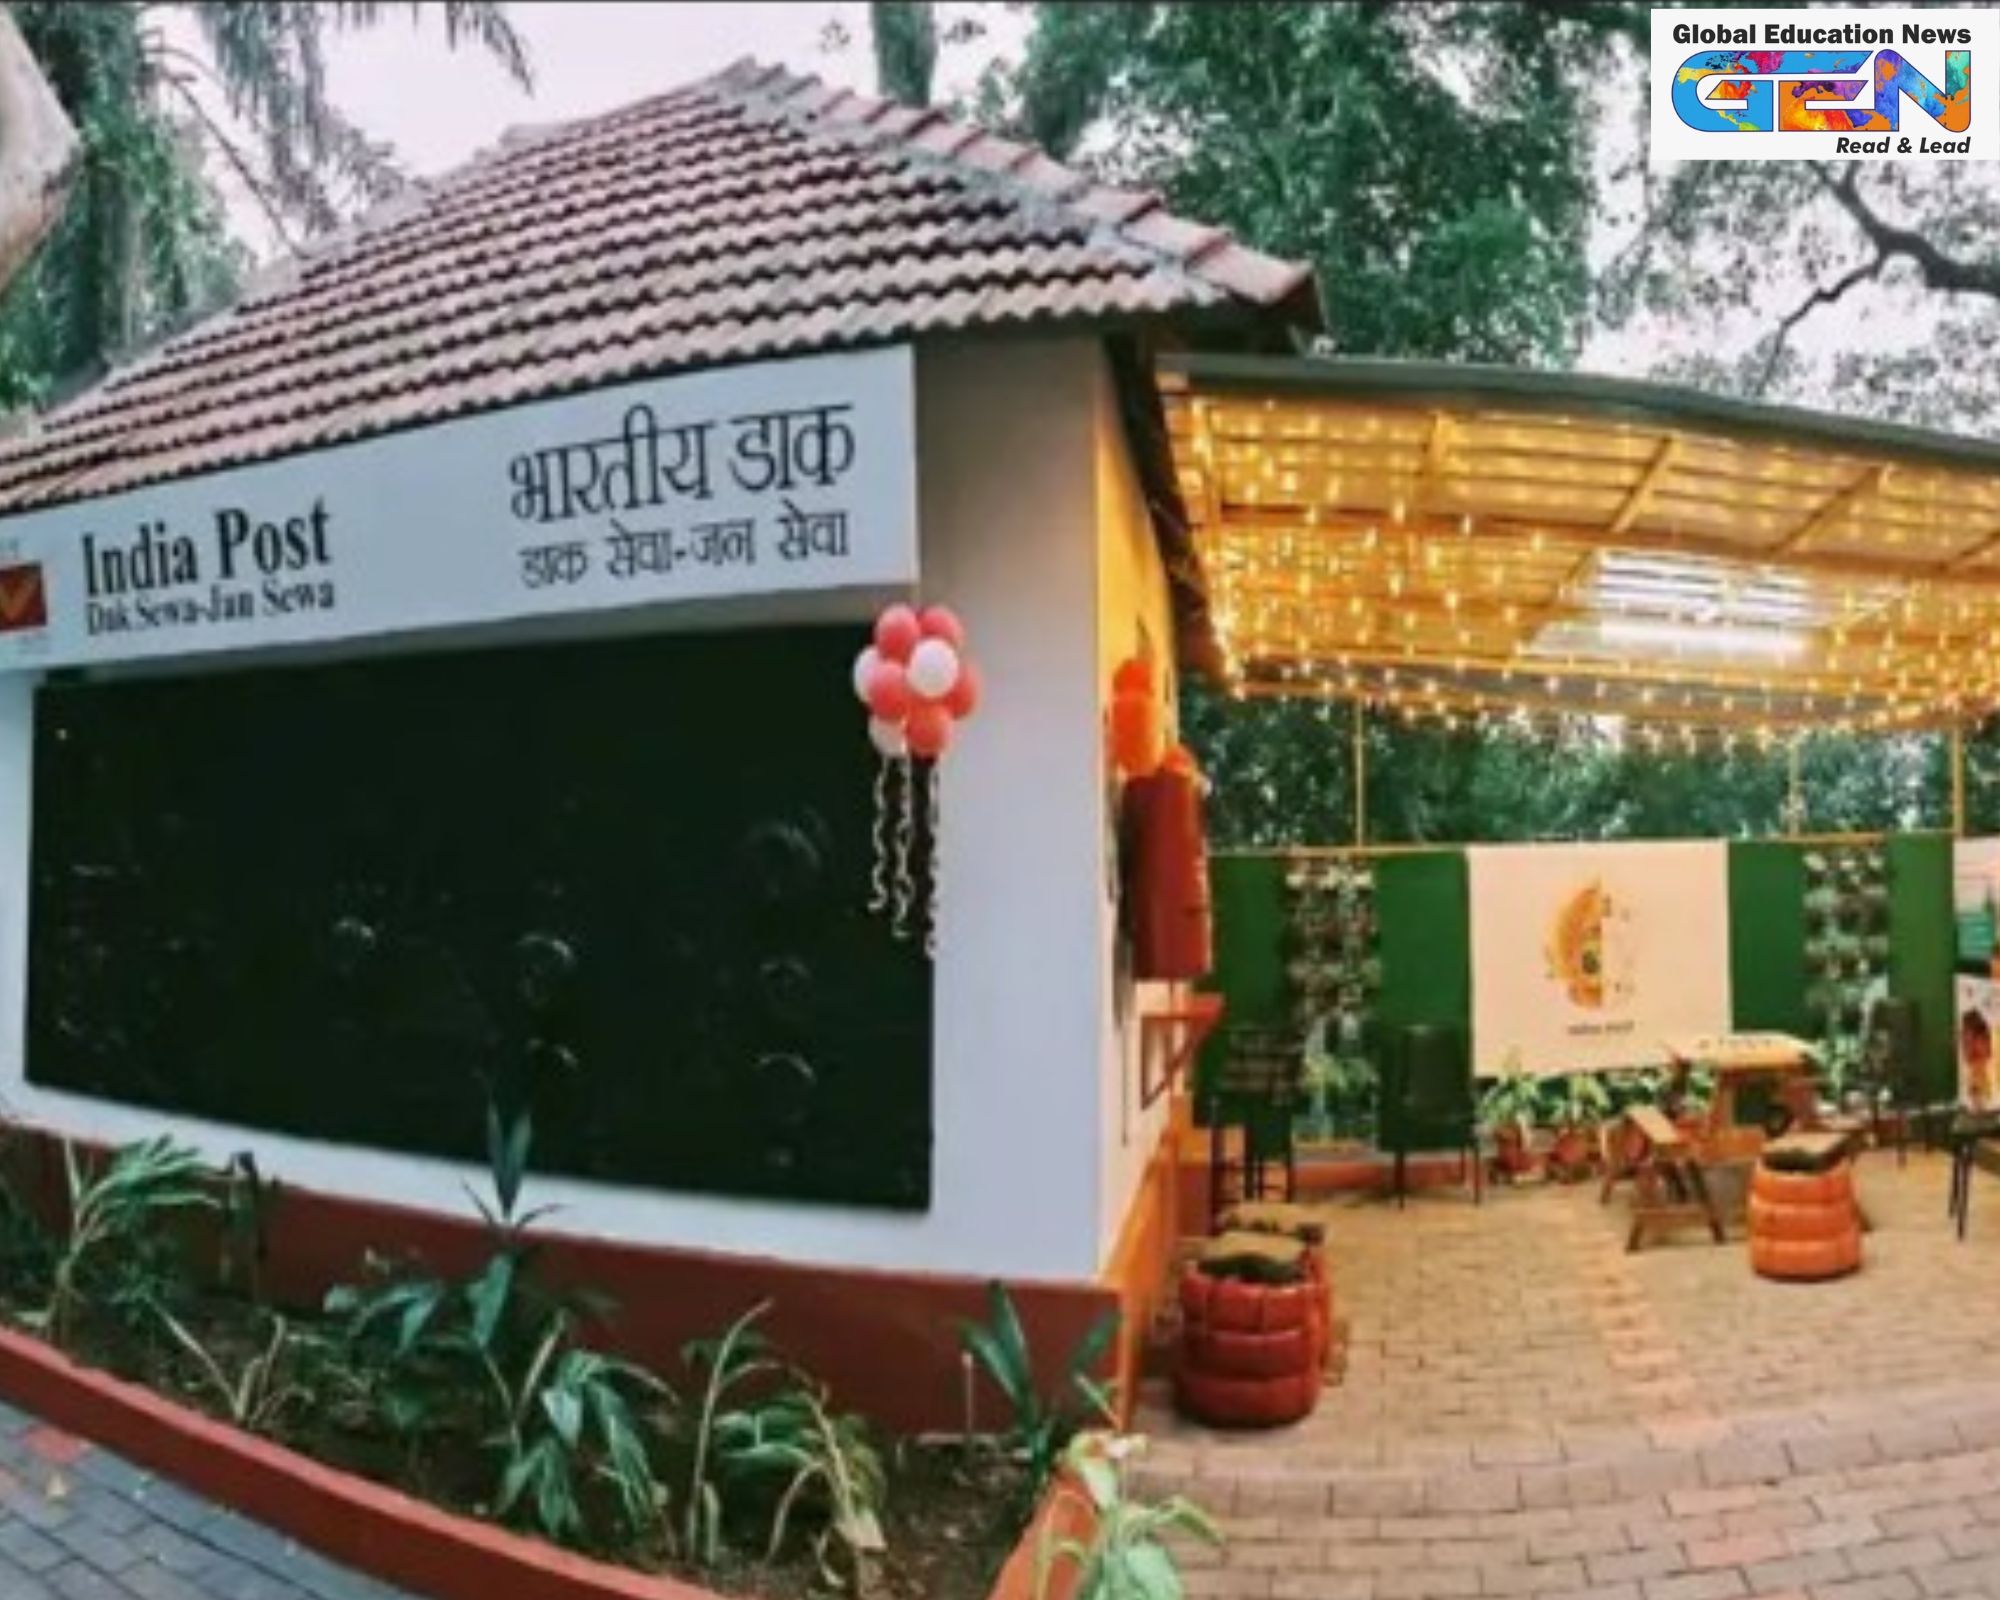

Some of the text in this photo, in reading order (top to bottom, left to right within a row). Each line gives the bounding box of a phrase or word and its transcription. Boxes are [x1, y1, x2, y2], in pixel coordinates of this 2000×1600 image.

[509, 402, 855, 523] भारतीय डाक
[82, 496, 331, 598] India Post
[519, 541, 588, 589] डाक
[776, 499, 850, 561] सेवा
[261, 577, 335, 617] Sewa
